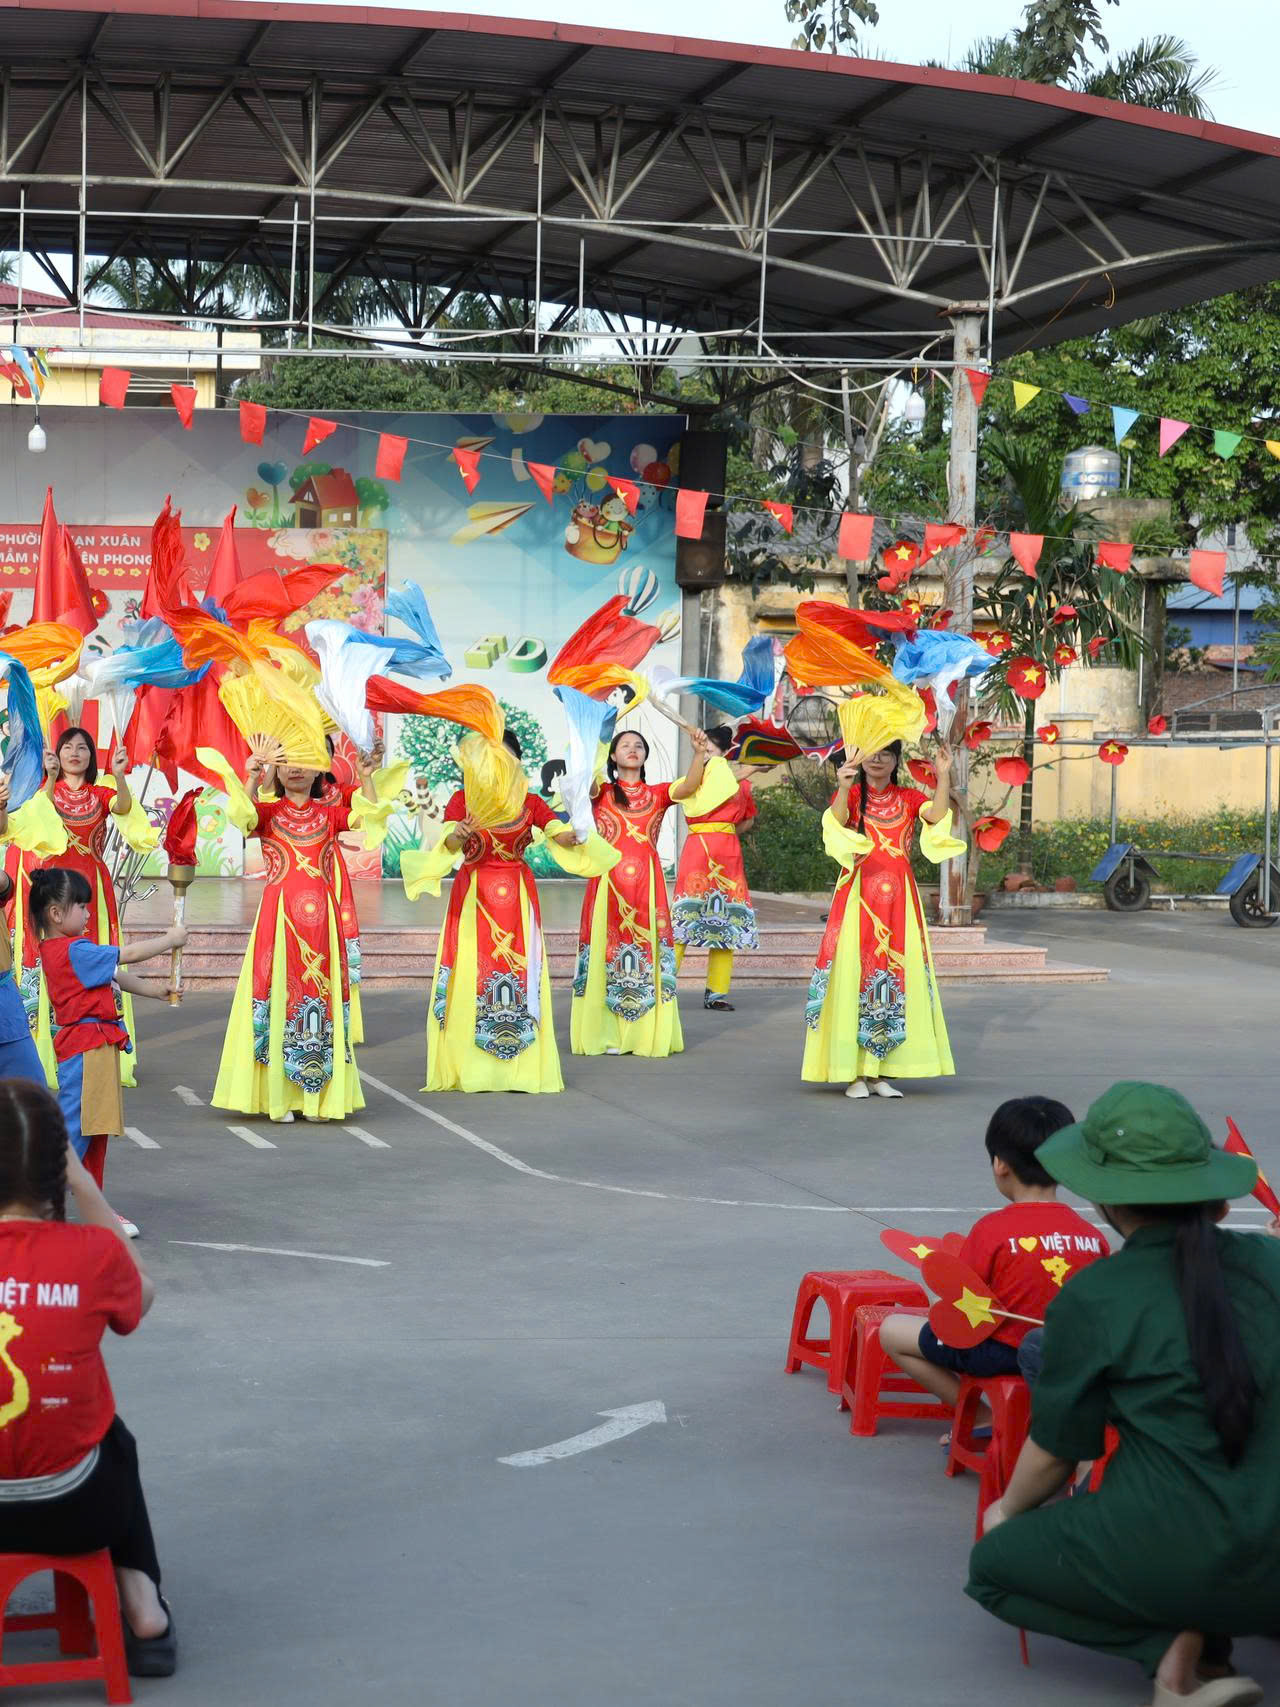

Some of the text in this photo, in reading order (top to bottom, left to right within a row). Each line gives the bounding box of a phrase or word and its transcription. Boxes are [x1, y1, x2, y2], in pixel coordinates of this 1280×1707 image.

[100, 533, 141, 547] XUÂN
[1008, 1237, 1018, 1254] I
[1039, 1231, 1072, 1254] VIỆT
[37, 1282, 79, 1308] NAM
